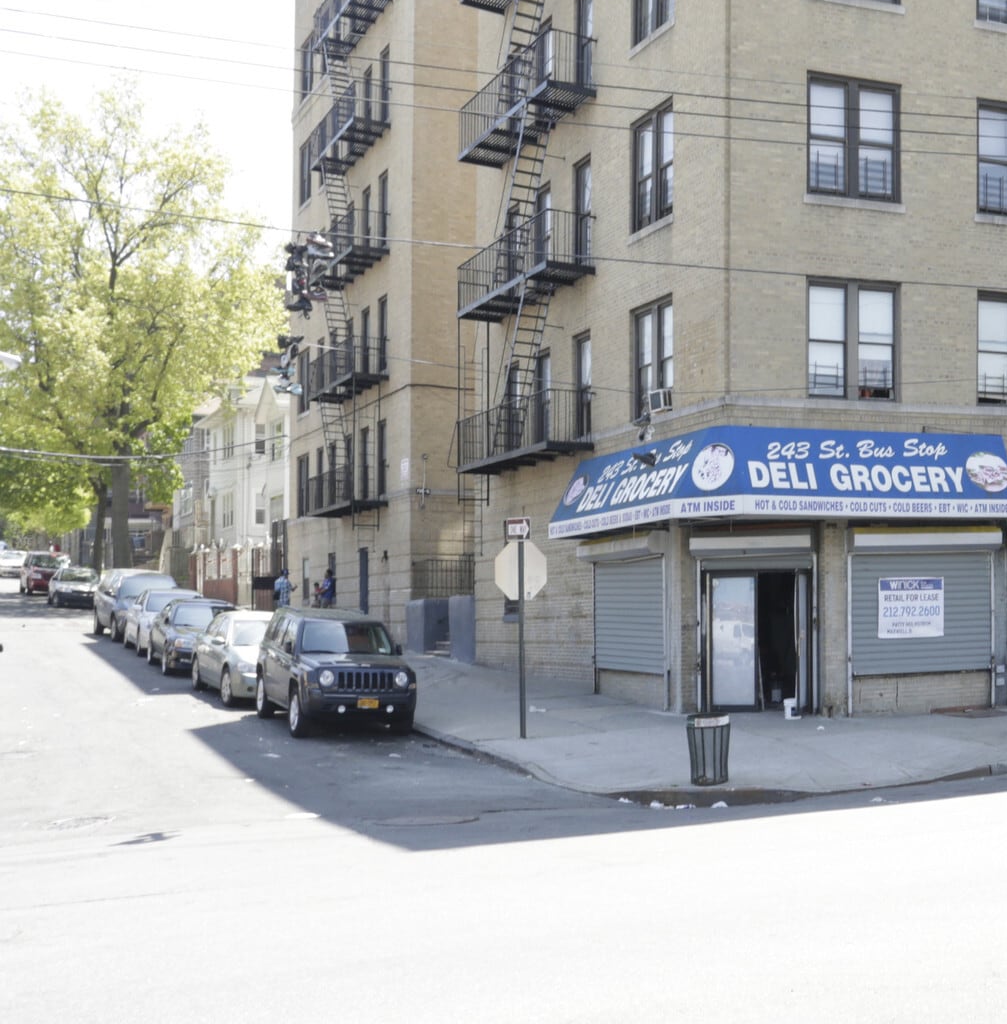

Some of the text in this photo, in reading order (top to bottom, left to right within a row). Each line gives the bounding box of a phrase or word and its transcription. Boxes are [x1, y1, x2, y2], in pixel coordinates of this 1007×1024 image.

[766, 438, 948, 461] 243 St. Bus Stop
[747, 460, 963, 493] DELI GROCERY
[576, 463, 689, 513] DELI GROCERY
[681, 500, 736, 513] ATM INSIDE
[754, 500, 770, 510] HOT
[779, 501, 797, 511] COLD
[799, 500, 843, 512] SANDWICHES
[850, 502, 867, 512] COLD
[869, 502, 887, 512] CUTS
[893, 502, 910, 513] COLD
[912, 502, 932, 513] BEERS
[974, 503, 987, 513] ATM
[884, 593, 938, 602] RETAIL FOR LEASE
